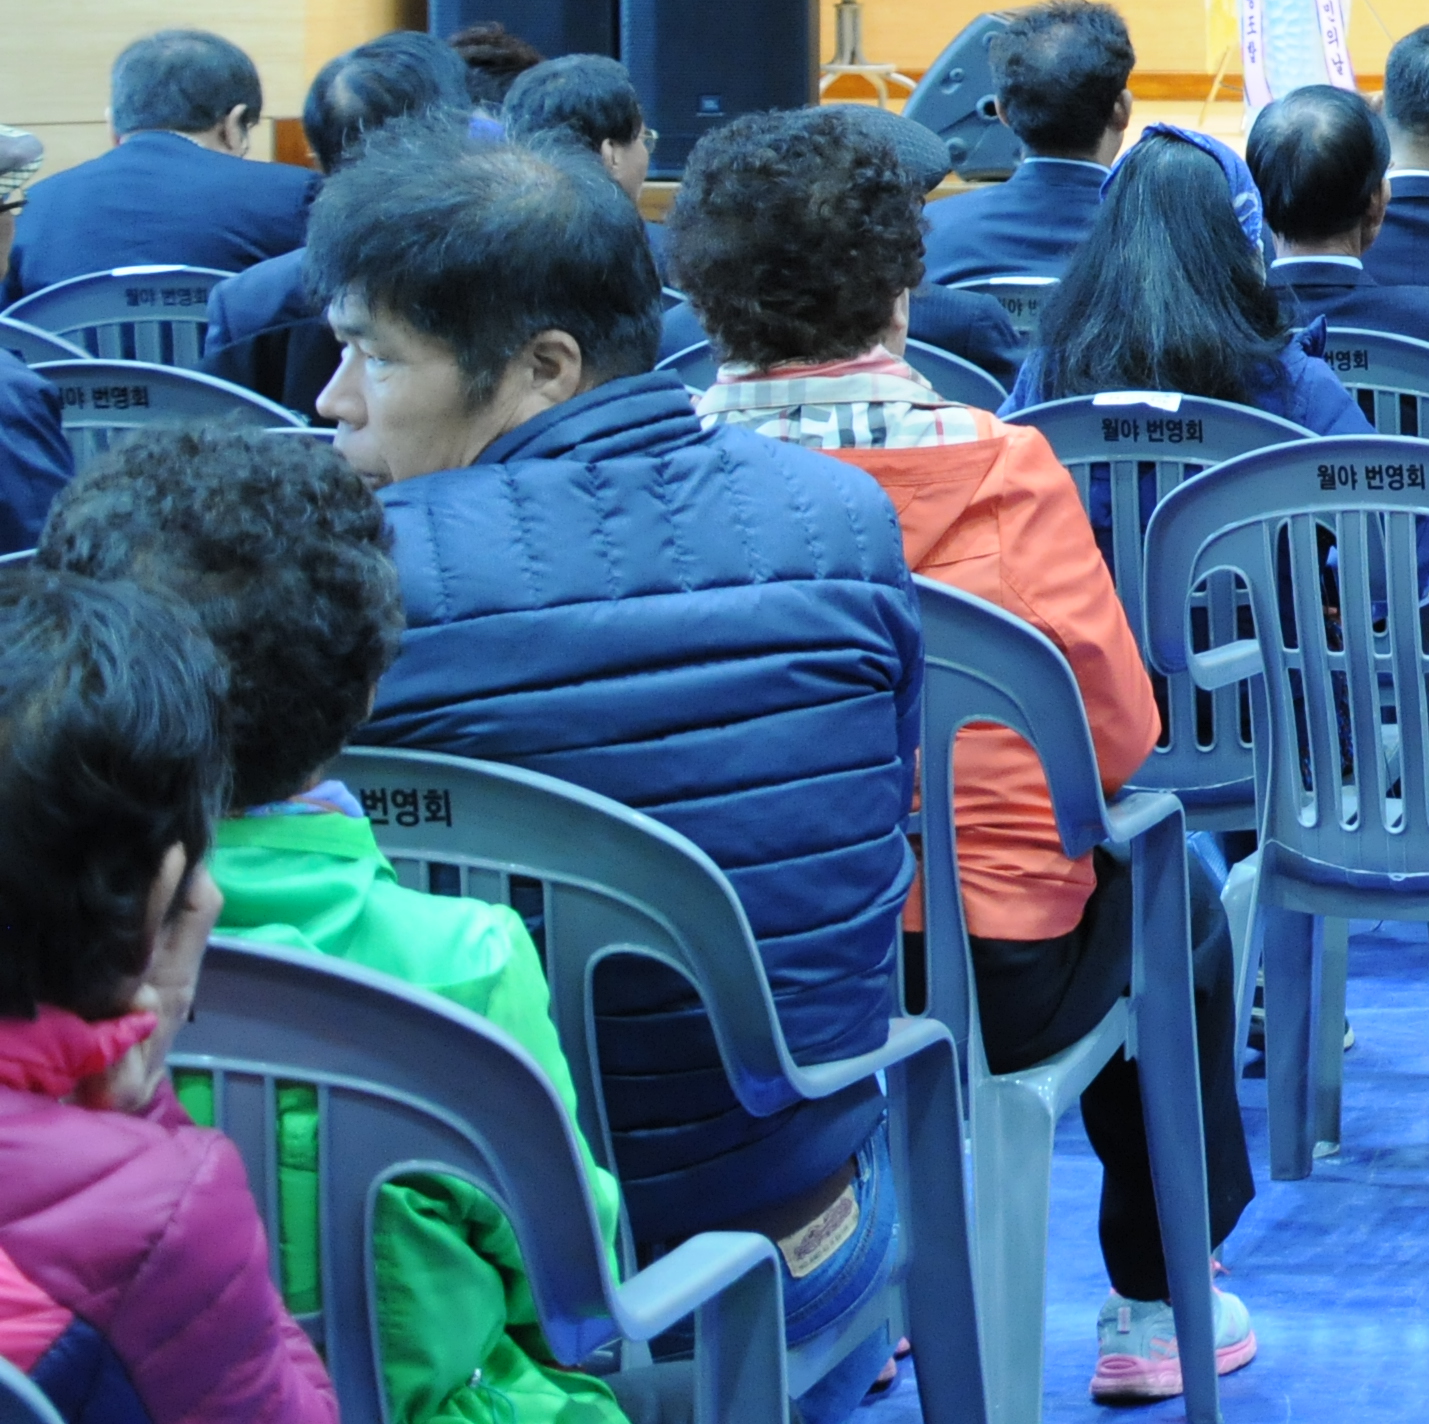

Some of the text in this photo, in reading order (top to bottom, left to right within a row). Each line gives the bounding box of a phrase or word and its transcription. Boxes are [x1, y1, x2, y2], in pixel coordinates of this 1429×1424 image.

[92, 385, 150, 410] 번영회
[1101, 418, 1204, 444] 월야 번영회
[1316, 463, 1426, 491] 월야 번영회
